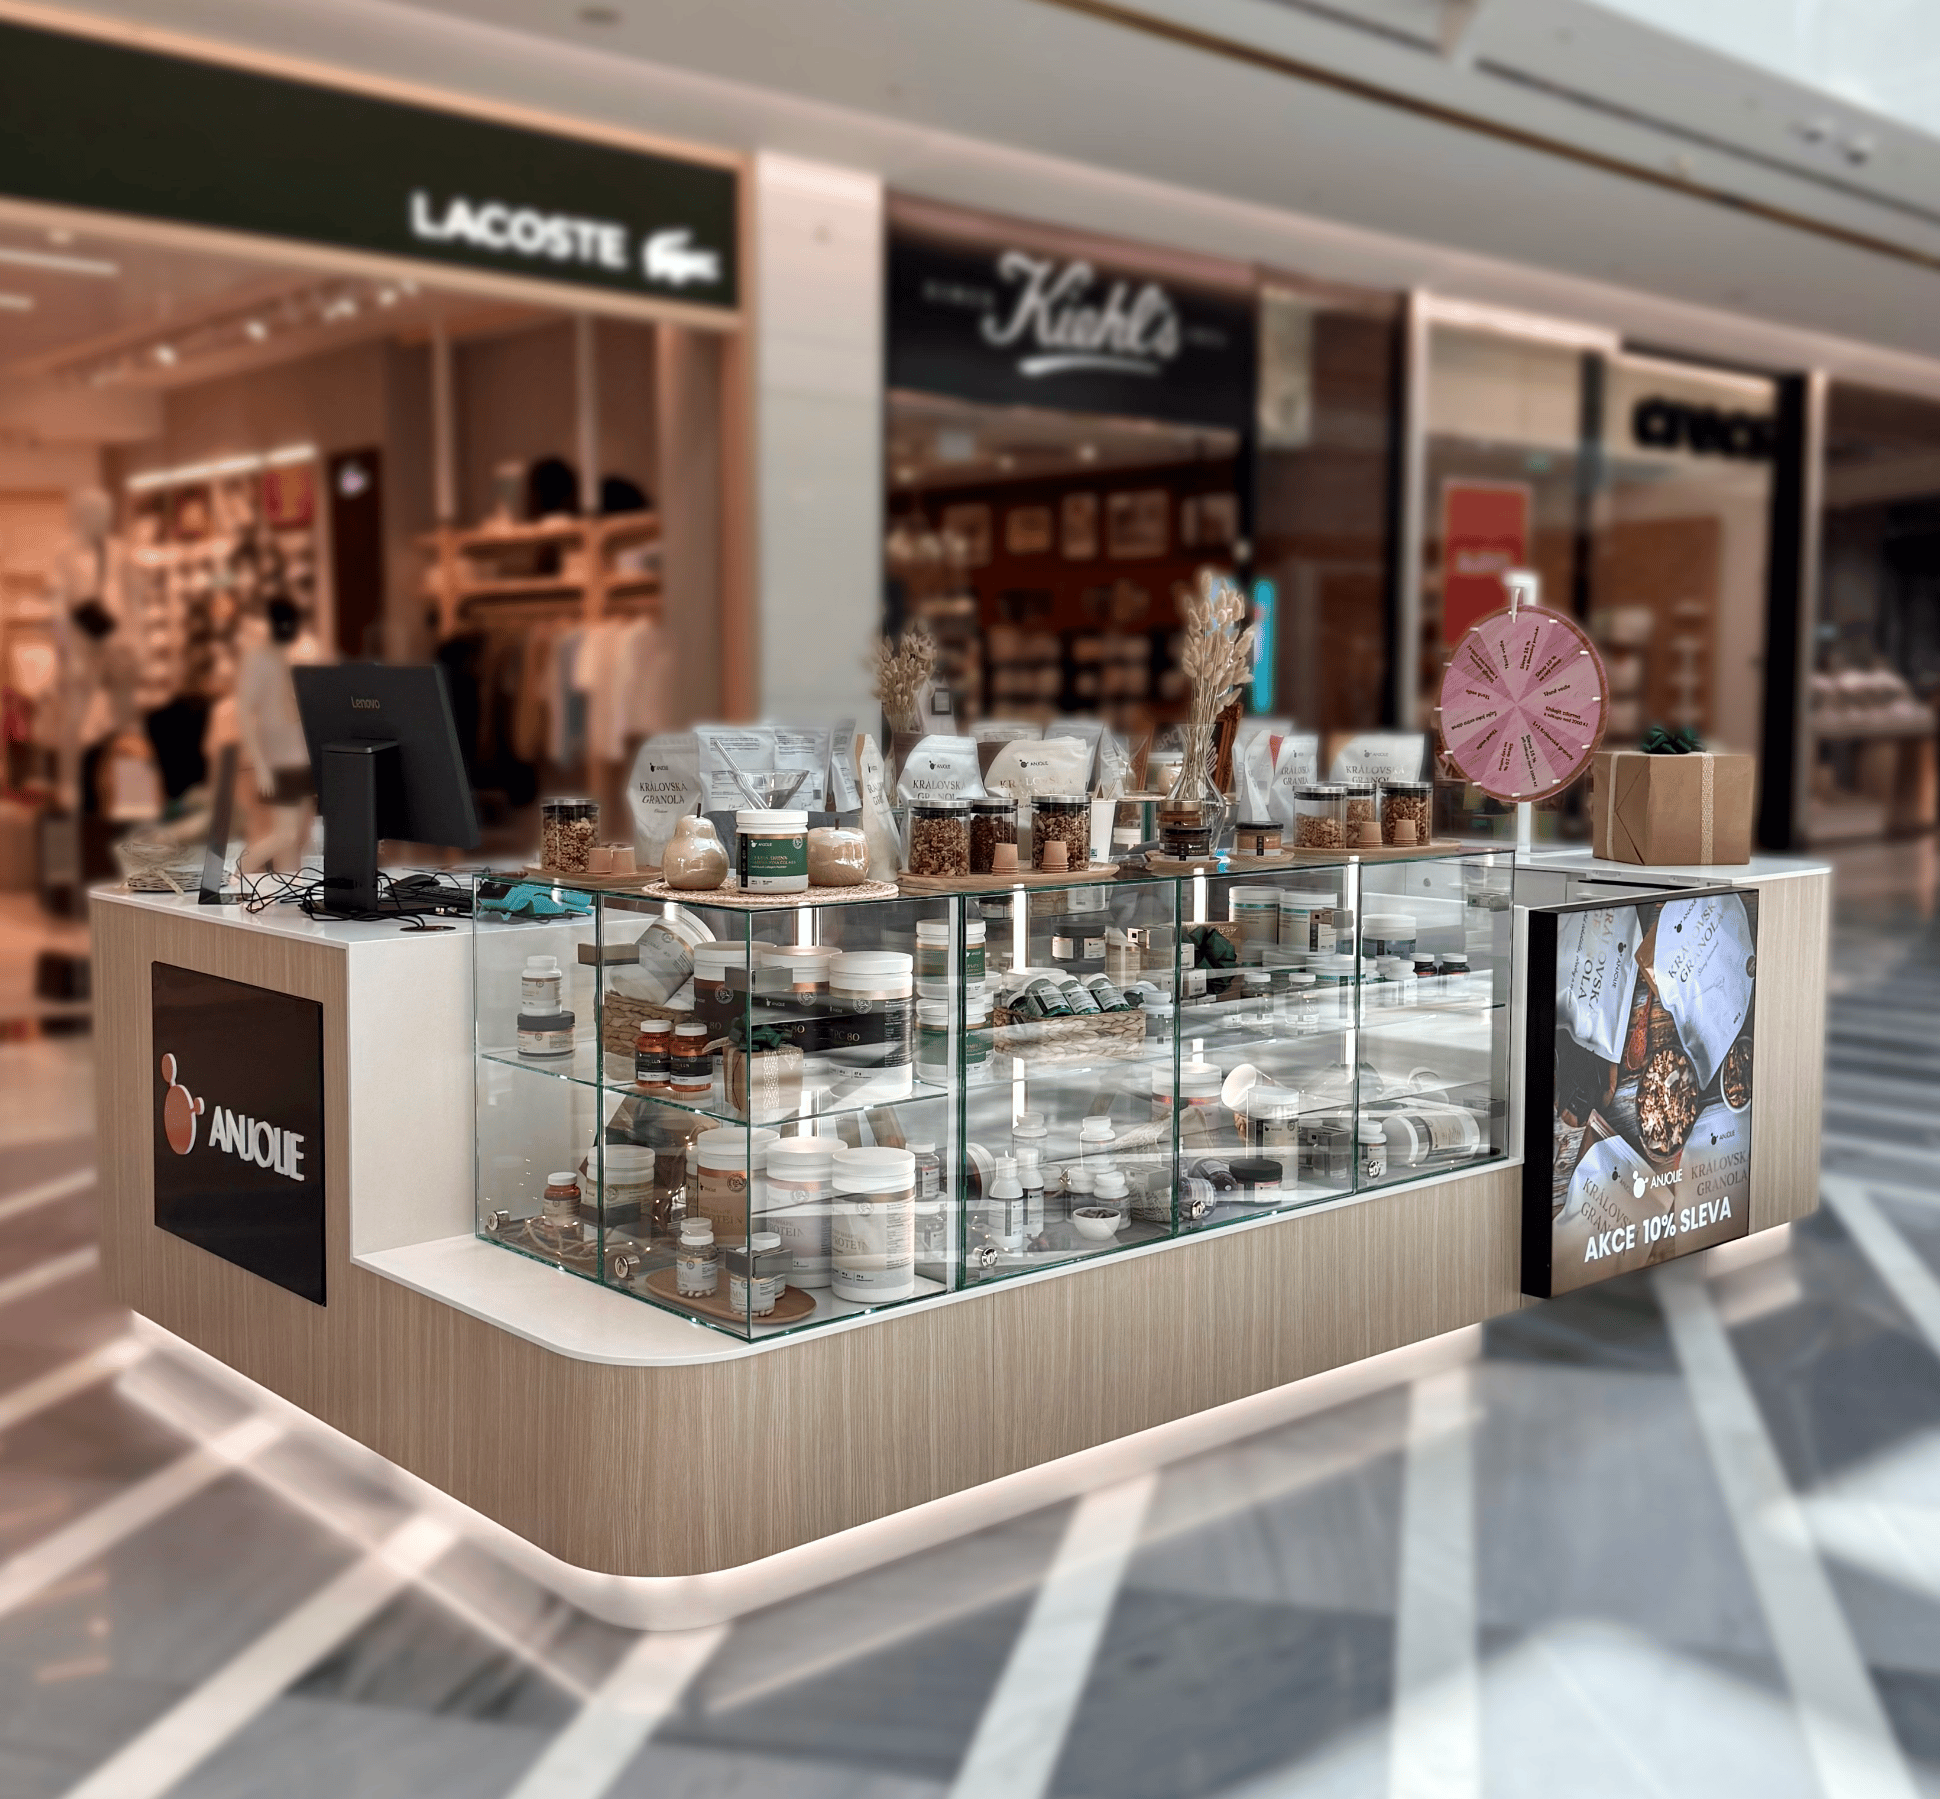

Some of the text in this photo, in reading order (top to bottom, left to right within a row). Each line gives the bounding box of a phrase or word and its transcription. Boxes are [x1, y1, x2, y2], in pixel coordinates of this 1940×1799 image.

[408, 190, 628, 269] LACOSTE
[350, 696, 380, 710] Lenovo
[639, 780, 688, 792] KRÁLOVSKÁ
[642, 794, 685, 804] GRANOLA
[846, 1032, 860, 1042] 80
[208, 1105, 305, 1182] ANJOLIE
[1650, 1168, 1683, 1190] ANJOLIE
[1696, 1168, 1748, 1196] GRANOLA
[1584, 1196, 1732, 1263] AKCE 10% SLEVA
